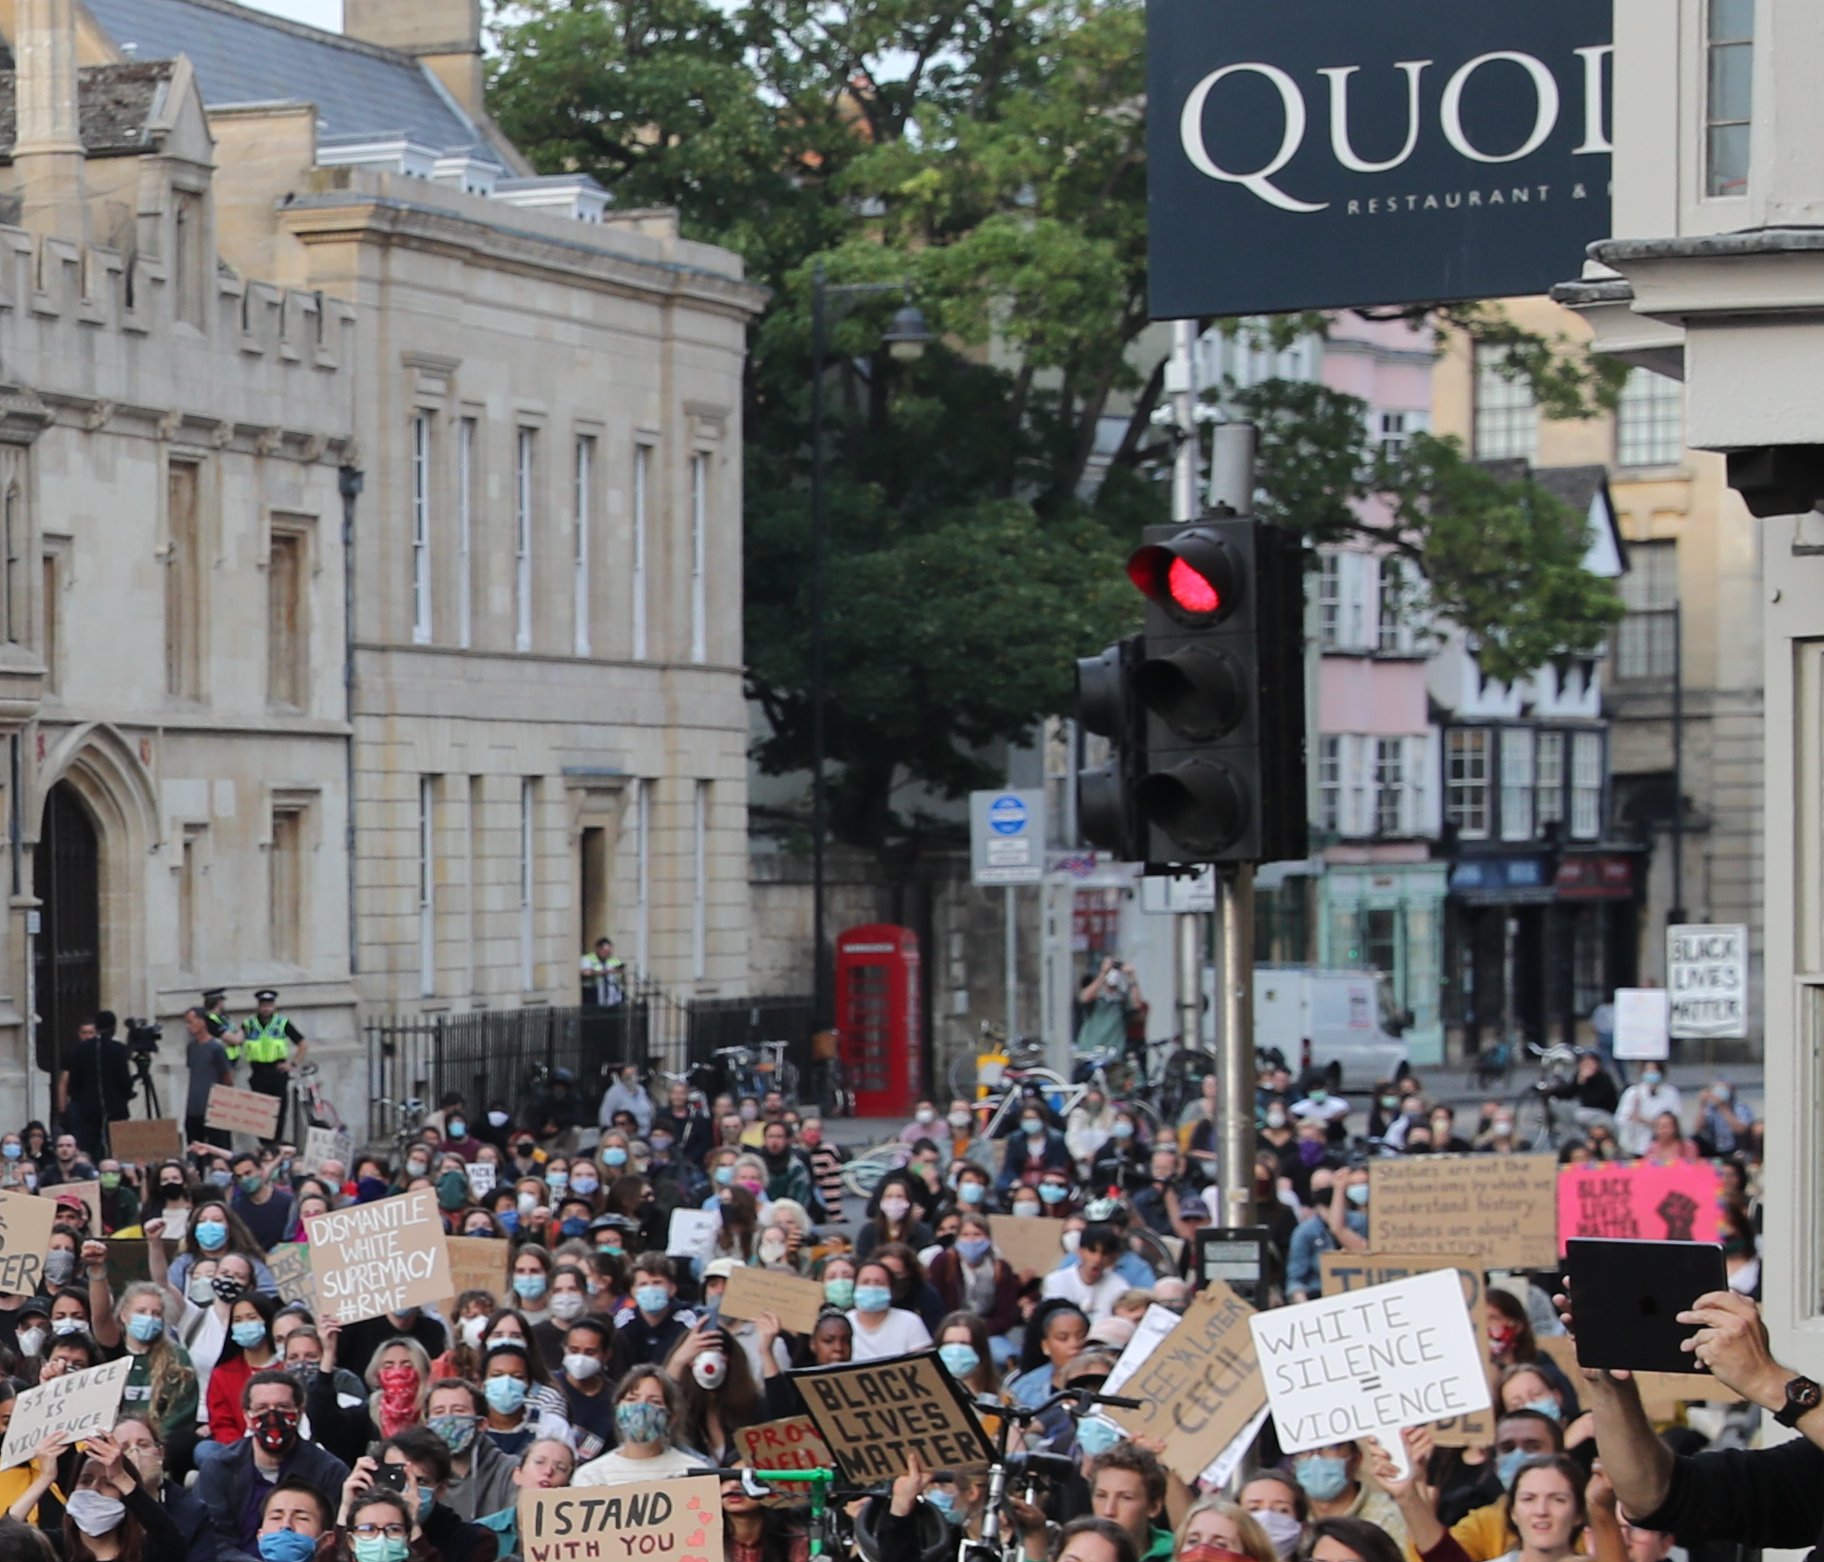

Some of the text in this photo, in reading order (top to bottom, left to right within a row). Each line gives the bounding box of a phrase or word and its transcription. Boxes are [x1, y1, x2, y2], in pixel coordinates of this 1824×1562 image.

[1348, 183, 1586, 215] RESTAURANT &
[1674, 936, 1735, 961] BLACK
[1675, 965, 1736, 989] LIVES
[1378, 1164, 1439, 1180] Statues
[1475, 1161, 1499, 1175] not
[1577, 1177, 1631, 1199] BLACK
[311, 1195, 430, 1247] DISMANTLE
[1378, 1196, 1536, 1218] understand history
[1581, 1200, 1633, 1219] LIVES
[340, 1230, 403, 1265] WHITE
[1378, 1220, 1441, 1239] Statues
[323, 1247, 436, 1298] SUPREMACY
[336, 1286, 407, 1322] #RMF
[1259, 1295, 1410, 1356] WHITE
[1276, 1327, 1444, 1395] SILENCE
[23, 1365, 118, 1413] SILENCE
[811, 1365, 932, 1412] BLACK
[1172, 1350, 1254, 1435] CECIL
[46, 1400, 64, 1419] IS
[832, 1402, 950, 1443] LIVES
[1282, 1376, 1467, 1444] VIOLENCE
[8, 1412, 103, 1456] VIOLENCE
[836, 1431, 985, 1481] MATTER
[554, 1492, 672, 1535] STAND
[531, 1533, 674, 1562] WITH YOU
